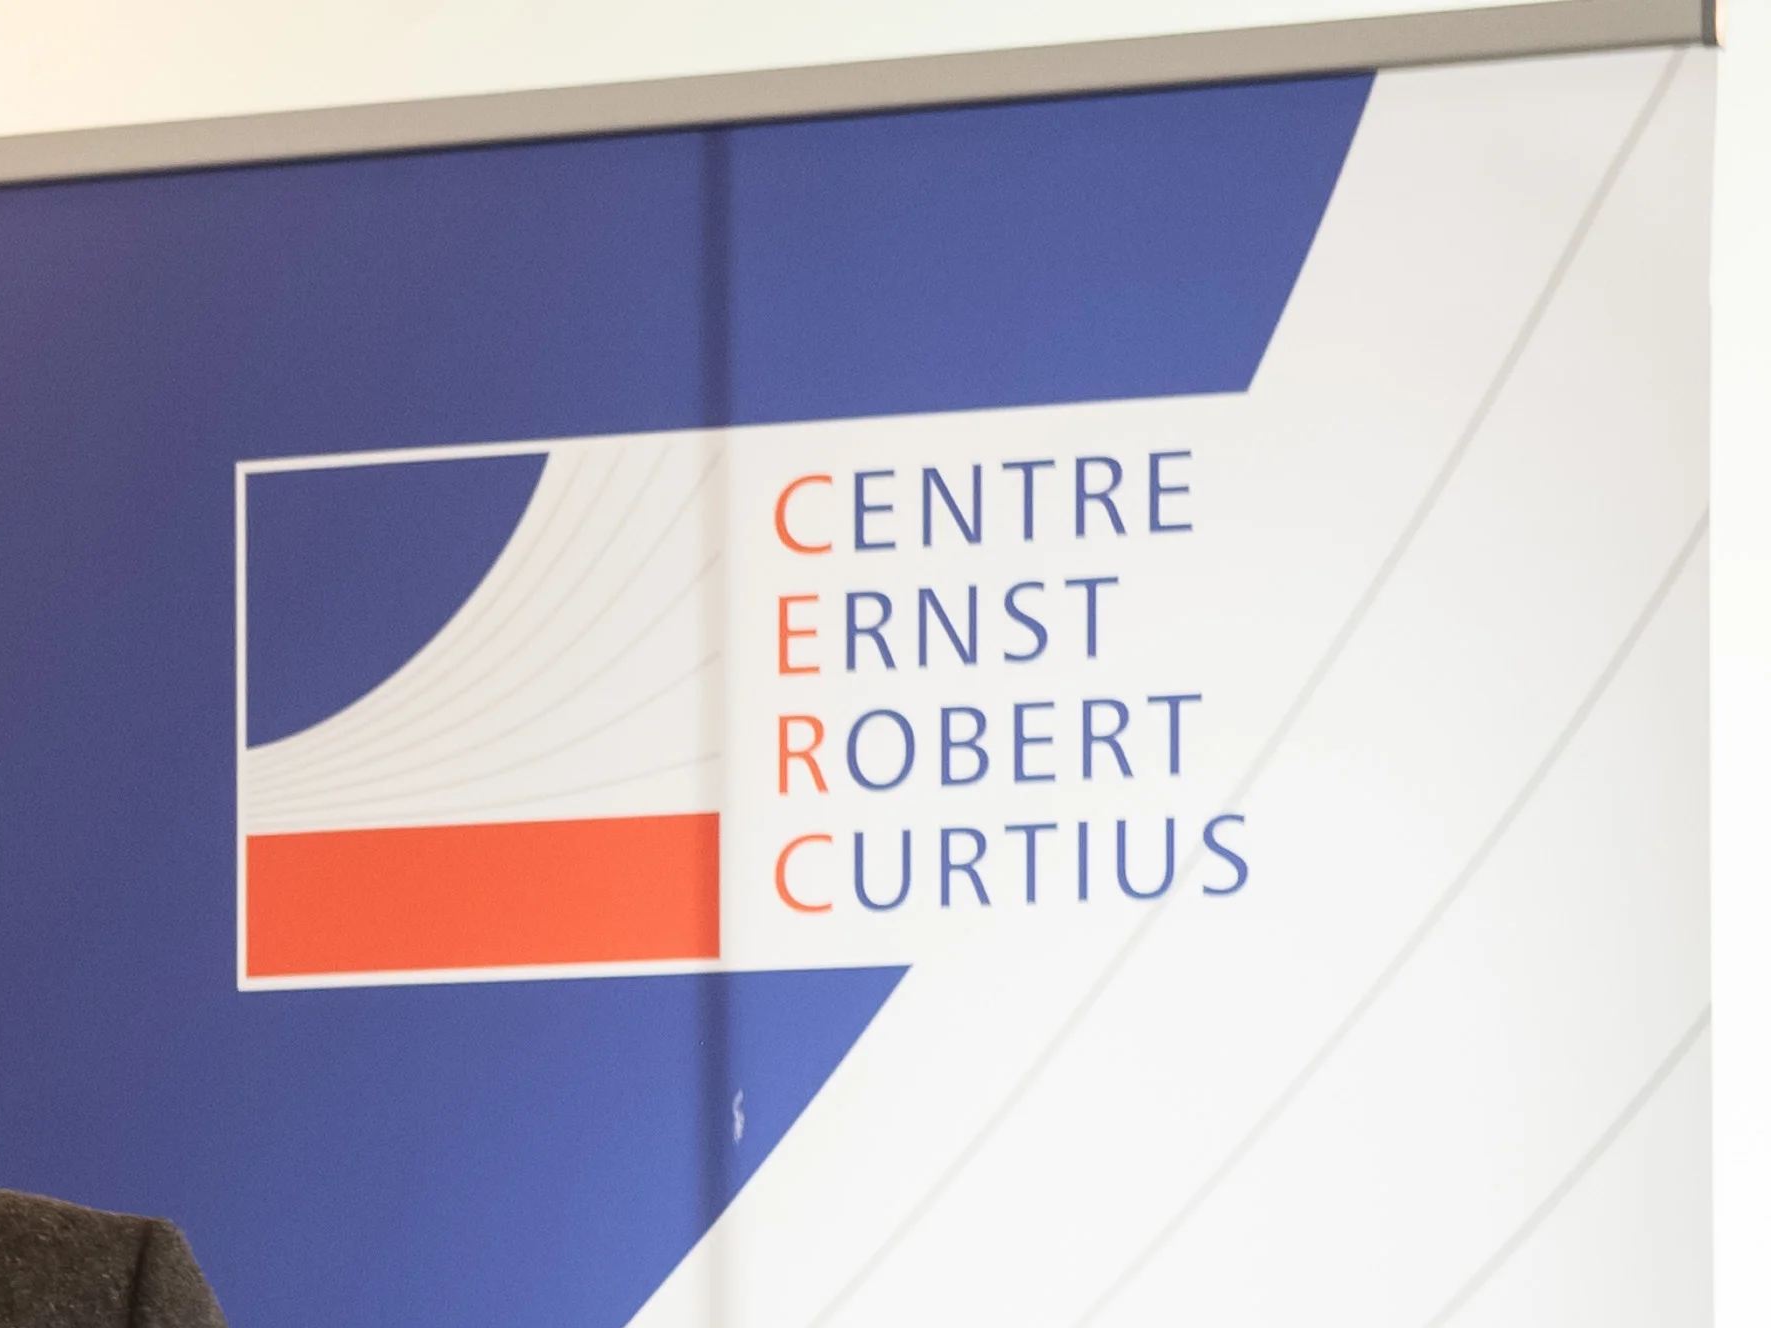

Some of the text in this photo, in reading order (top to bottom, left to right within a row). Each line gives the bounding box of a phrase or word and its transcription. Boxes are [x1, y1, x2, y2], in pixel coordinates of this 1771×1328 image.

[772, 451, 1192, 557] CENTRE
[776, 576, 1119, 677] ERNST
[776, 693, 1202, 797] ROBERT
[772, 813, 1249, 915] CURTIUS
